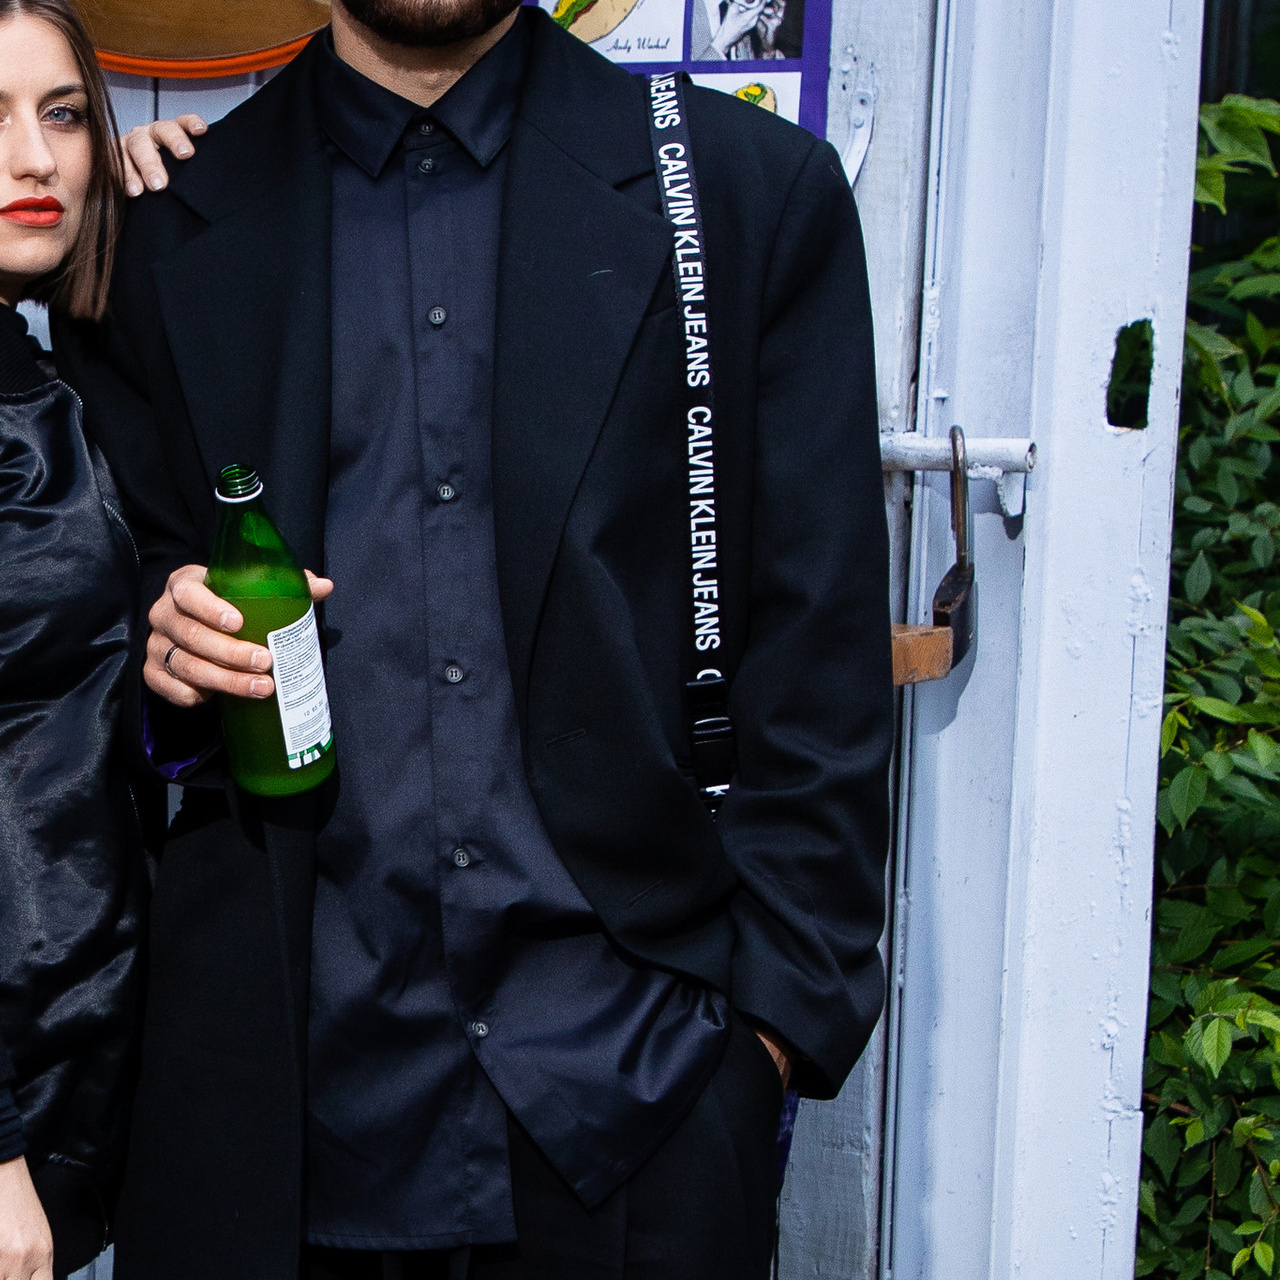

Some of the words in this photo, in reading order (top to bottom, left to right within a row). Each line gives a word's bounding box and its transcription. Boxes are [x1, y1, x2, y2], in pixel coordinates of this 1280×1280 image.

[650, 72, 681, 129] JEANS
[658, 143, 696, 225] CALVIN
[673, 229, 705, 302] KLEIN
[684, 304, 710, 387] JEANS
[687, 406, 714, 494] CALVIN
[690, 499, 717, 570] KLEIN
[693, 573, 721, 651] JEANS
